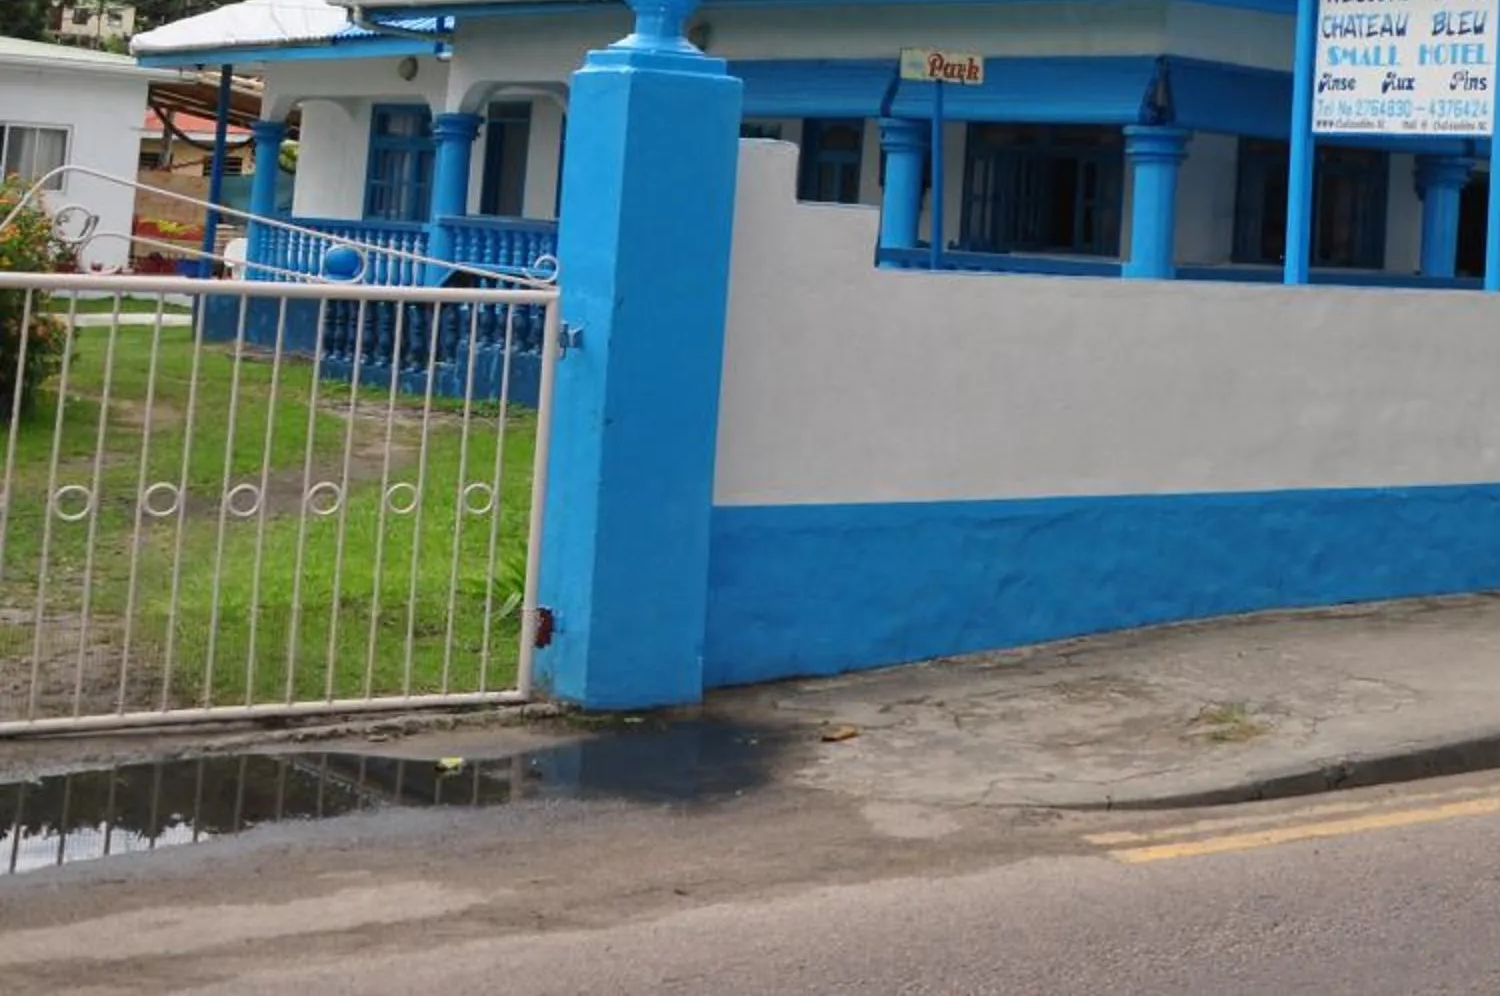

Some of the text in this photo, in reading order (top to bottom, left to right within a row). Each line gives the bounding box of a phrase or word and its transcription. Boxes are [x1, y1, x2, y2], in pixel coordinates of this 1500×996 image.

[1321, 10, 1488, 39] CHATEAU BLEU
[927, 53, 980, 80] Park
[1327, 43, 1492, 66] SMALL HOTEL
[1318, 70, 1488, 94] Anse Aux Pins
